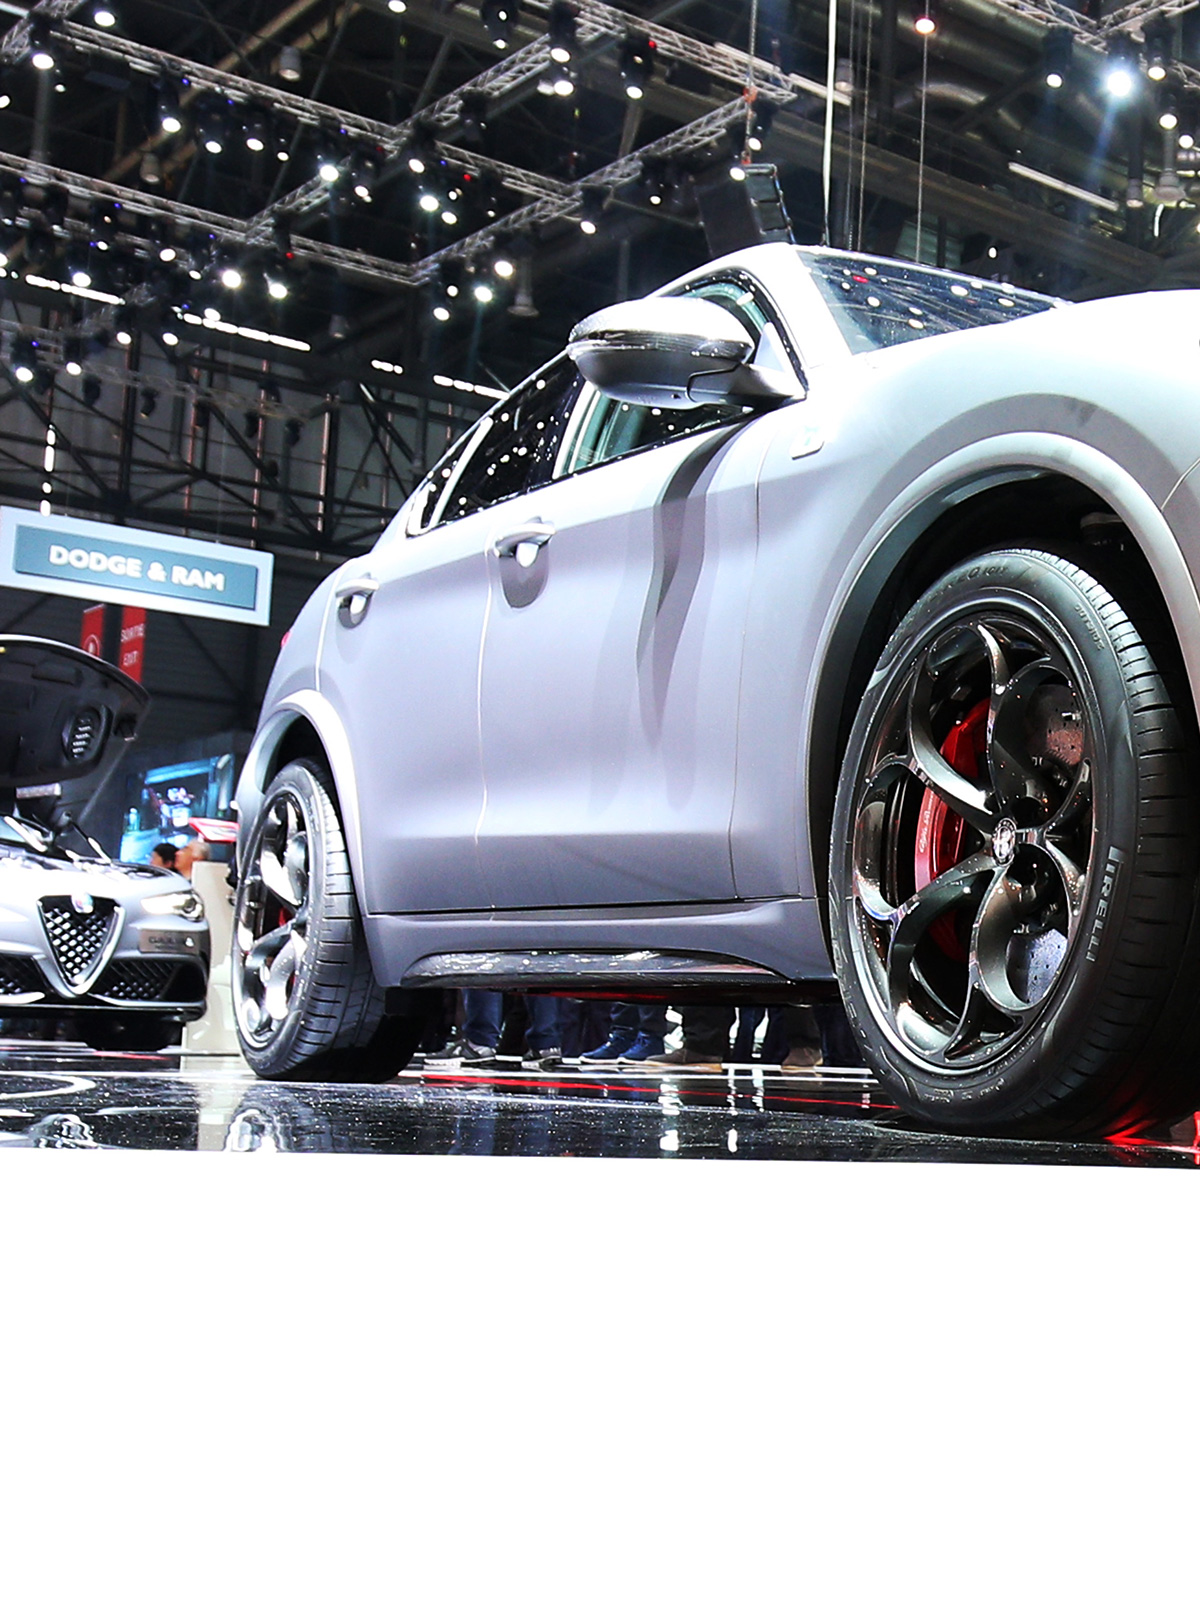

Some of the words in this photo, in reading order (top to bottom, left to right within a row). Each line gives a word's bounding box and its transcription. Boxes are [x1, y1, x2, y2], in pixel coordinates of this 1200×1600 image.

[49, 544, 143, 579] DODGE
[147, 561, 168, 583] &
[171, 565, 226, 592] RAM
[123, 651, 139, 666] EXIT
[1086, 846, 1124, 962] PIRELLI
